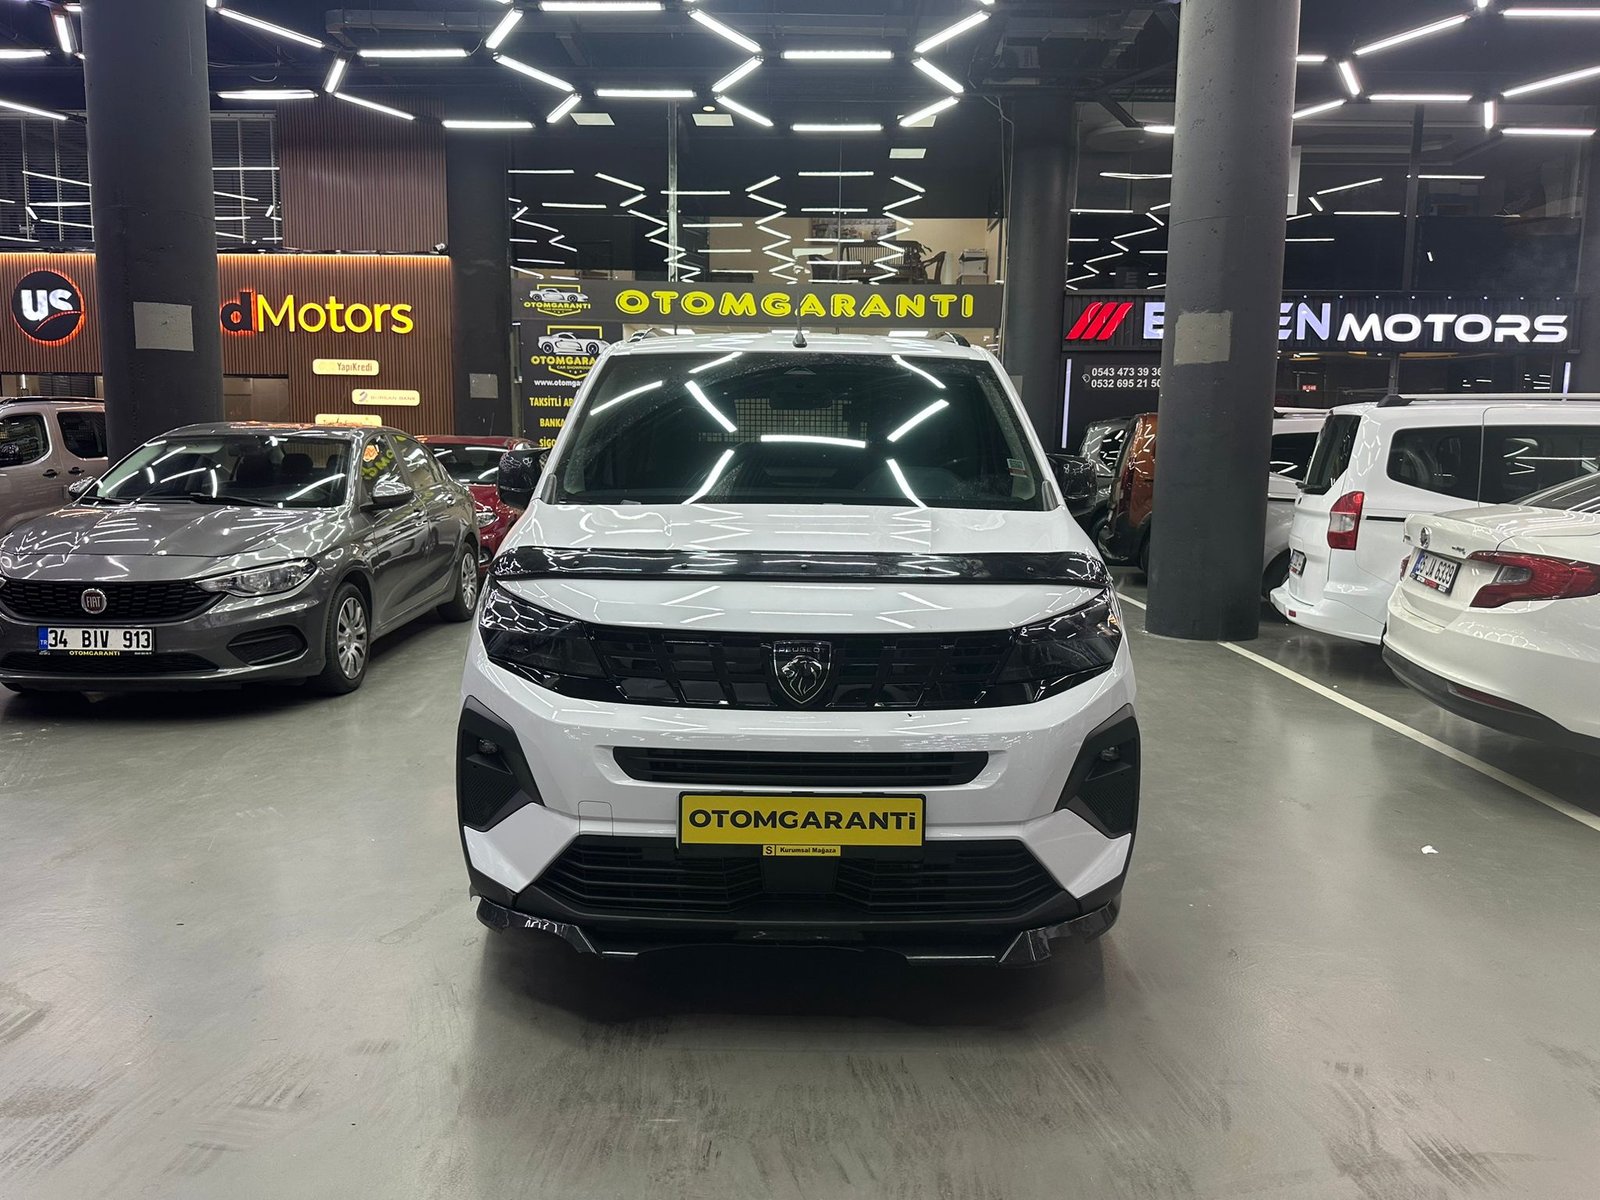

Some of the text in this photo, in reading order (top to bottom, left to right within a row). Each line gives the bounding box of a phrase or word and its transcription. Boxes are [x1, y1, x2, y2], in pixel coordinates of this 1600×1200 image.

[523, 301, 591, 310] OTOMGARANTI
[614, 288, 975, 318] OTOMGARANTI
[1336, 312, 1568, 343] MOTORS
[1091, 367, 1115, 376] 0543
[1117, 367, 1135, 376] 473
[1137, 367, 1149, 376] 39
[1091, 379, 1115, 388] 0532
[1116, 379, 1134, 388] 695
[1136, 379, 1148, 388] 21
[529, 394, 562, 407] TAKSİTLİ
[86, 596, 101, 608] FIAT
[48, 629, 151, 649] 34 BIV 913
[765, 845, 837, 855] S Kurumsal Mağaza
